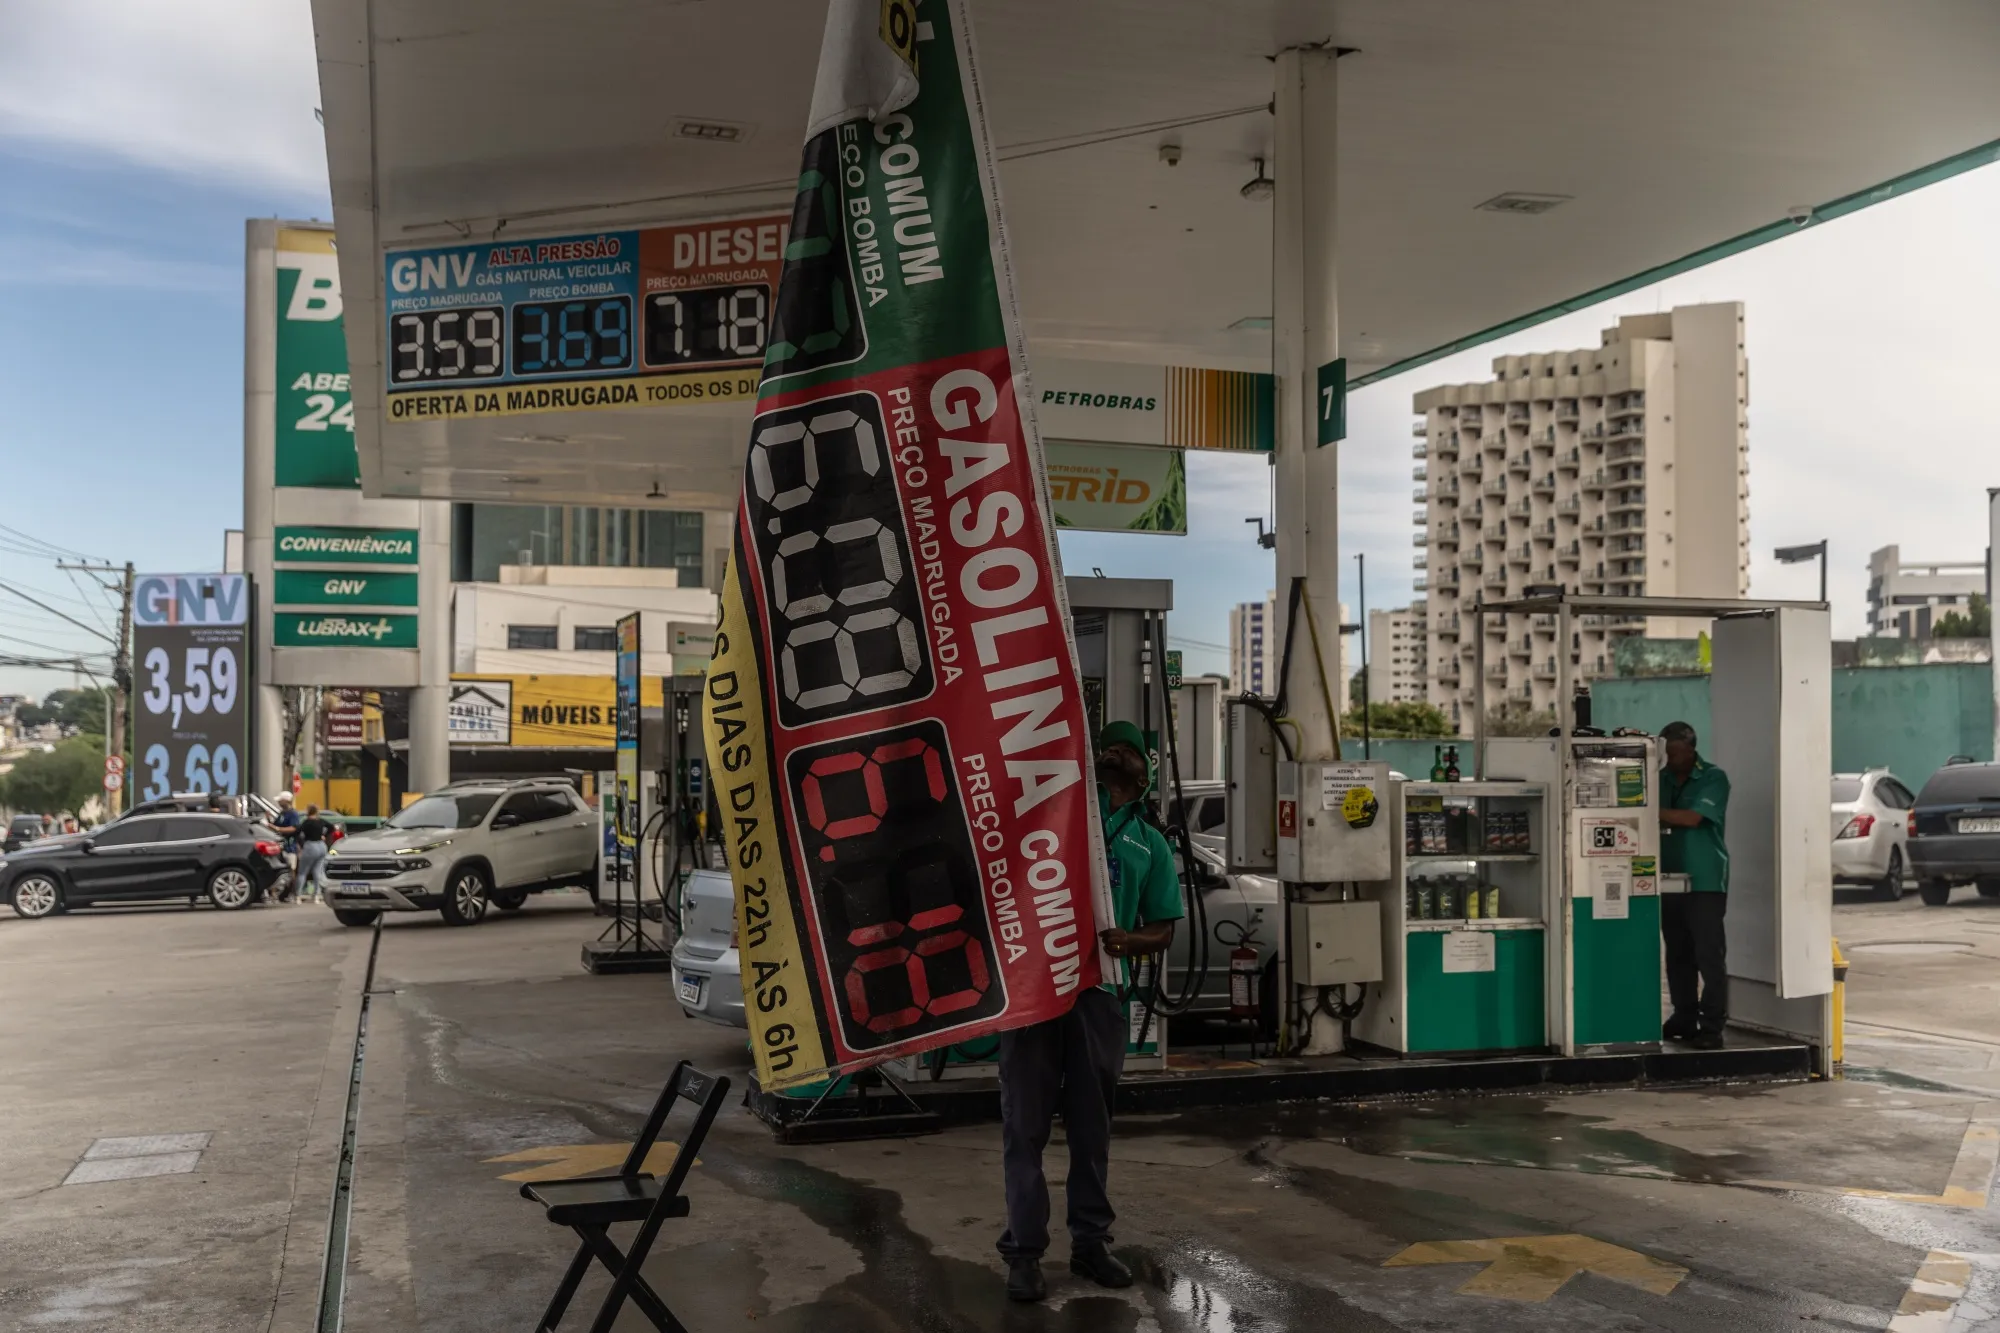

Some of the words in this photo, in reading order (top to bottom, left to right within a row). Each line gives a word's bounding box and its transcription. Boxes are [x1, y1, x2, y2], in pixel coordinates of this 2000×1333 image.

[842, 124, 865, 188] EÇO
[873, 113, 945, 286] COMUM
[391, 252, 478, 293] GNV
[475, 270, 503, 286] GÁS
[505, 268, 565, 284] NATURAL
[567, 261, 632, 278] VEICULAR
[488, 246, 534, 268] ALTA
[537, 238, 621, 265] PRESSÃO
[849, 196, 888, 308] BOMBA
[285, 267, 344, 322] B
[391, 297, 429, 313] PREÇO
[430, 291, 504, 308] MADRUGADA
[529, 285, 570, 301] PREÇO
[572, 281, 615, 296] BOMBA
[646, 275, 688, 290] PREÇO
[689, 268, 769, 286] MADRUGADA
[397, 309, 500, 379] 3.59
[520, 299, 629, 370] 3.69
[654, 288, 765, 358] 7.18
[291, 372, 352, 393] ABE
[391, 394, 468, 418] OFERTA
[474, 393, 501, 414] DA
[506, 383, 639, 411] MADRUGADA
[646, 383, 703, 401] TODOS
[708, 381, 732, 396] OS
[738, 379, 761, 394] DI
[1042, 389, 1156, 411] PETROBRAS
[1322, 385, 1334, 421] 7
[280, 535, 413, 557] CONVENIÊNCIA
[888, 386, 929, 488] PREÇO
[911, 495, 964, 687] MADRUGADA
[137, 578, 242, 622] GNV
[324, 579, 367, 595] GNV
[143, 646, 238, 730] 3,59
[930, 369, 1082, 819] GASOLINA
[1020, 829, 1081, 997] COMUM
[521, 700, 602, 725] MÓVEIS
[709, 670, 752, 772] DIAS
[730, 781, 763, 870] DAS
[1595, 828, 1614, 847] 64
[962, 753, 1005, 853] PREÇO
[988, 858, 1027, 965] BOMBA
[744, 877, 773, 949] 22h
[764, 1023, 799, 1072] 6h
